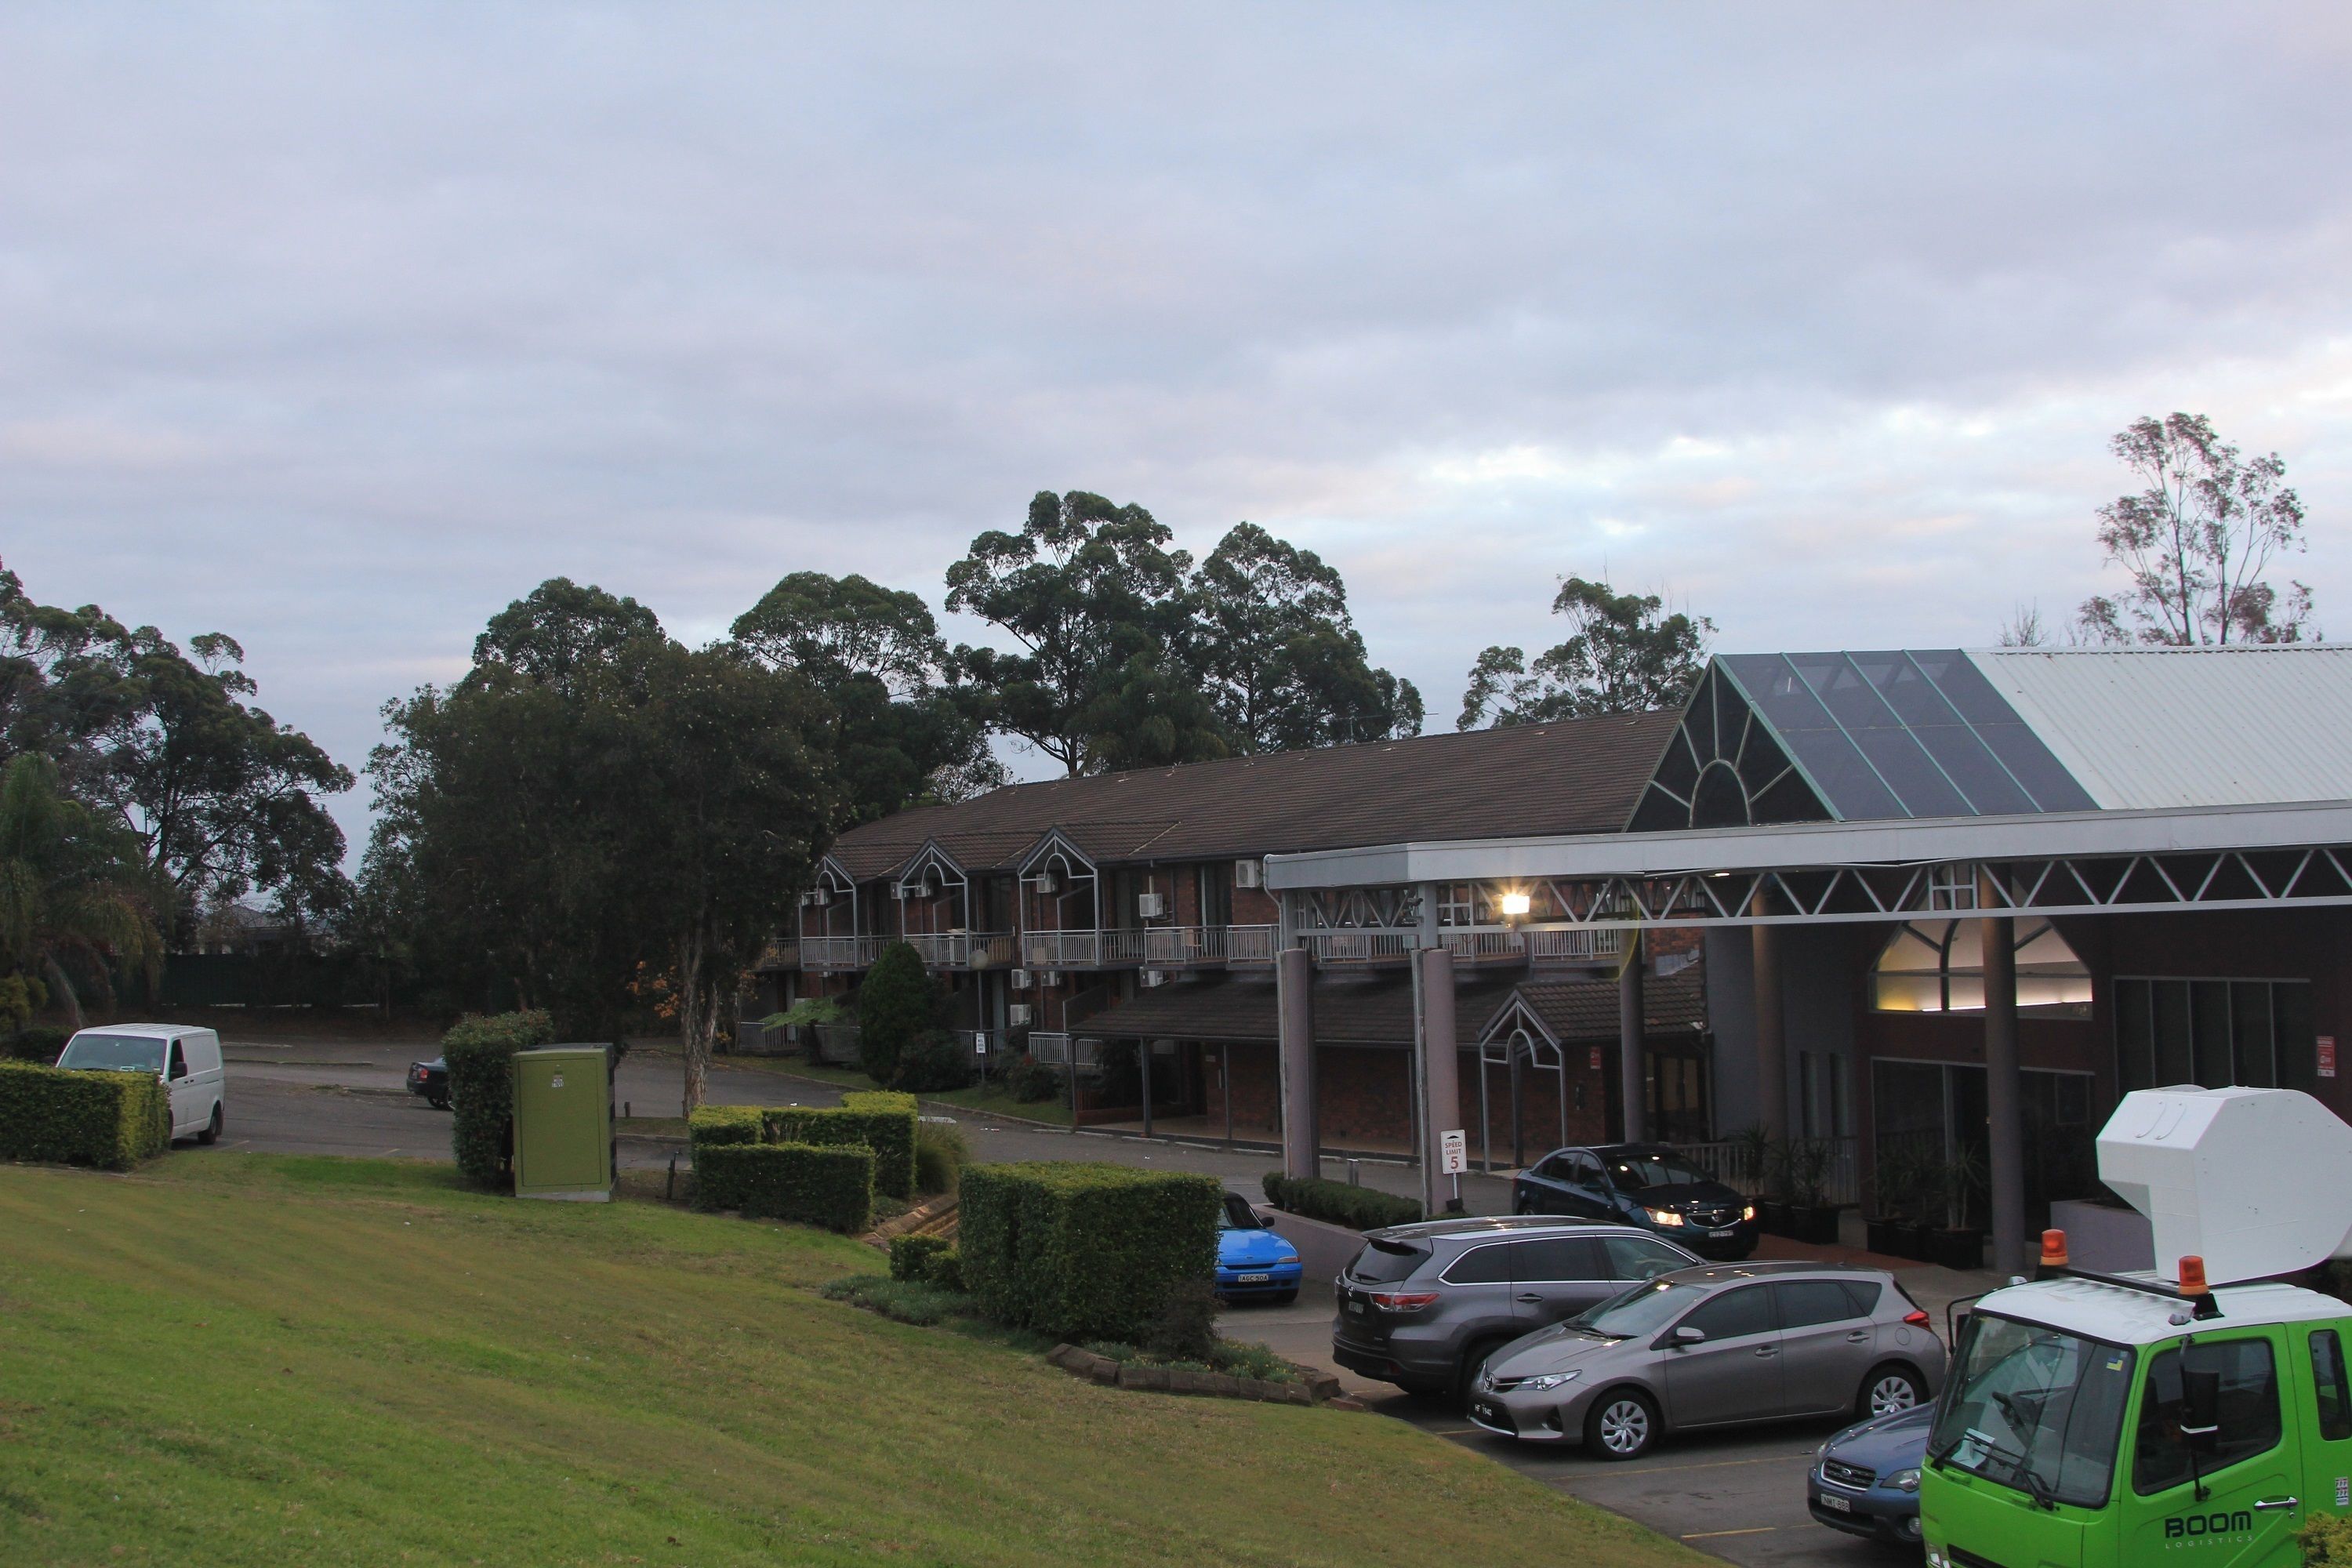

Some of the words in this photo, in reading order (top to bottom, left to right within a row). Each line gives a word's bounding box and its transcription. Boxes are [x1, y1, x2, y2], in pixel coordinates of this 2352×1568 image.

[1450, 1156, 1459, 1170] 5
[2165, 1511, 2252, 1538] BOOM
[2165, 1535, 2252, 1549] LOGISTICS
